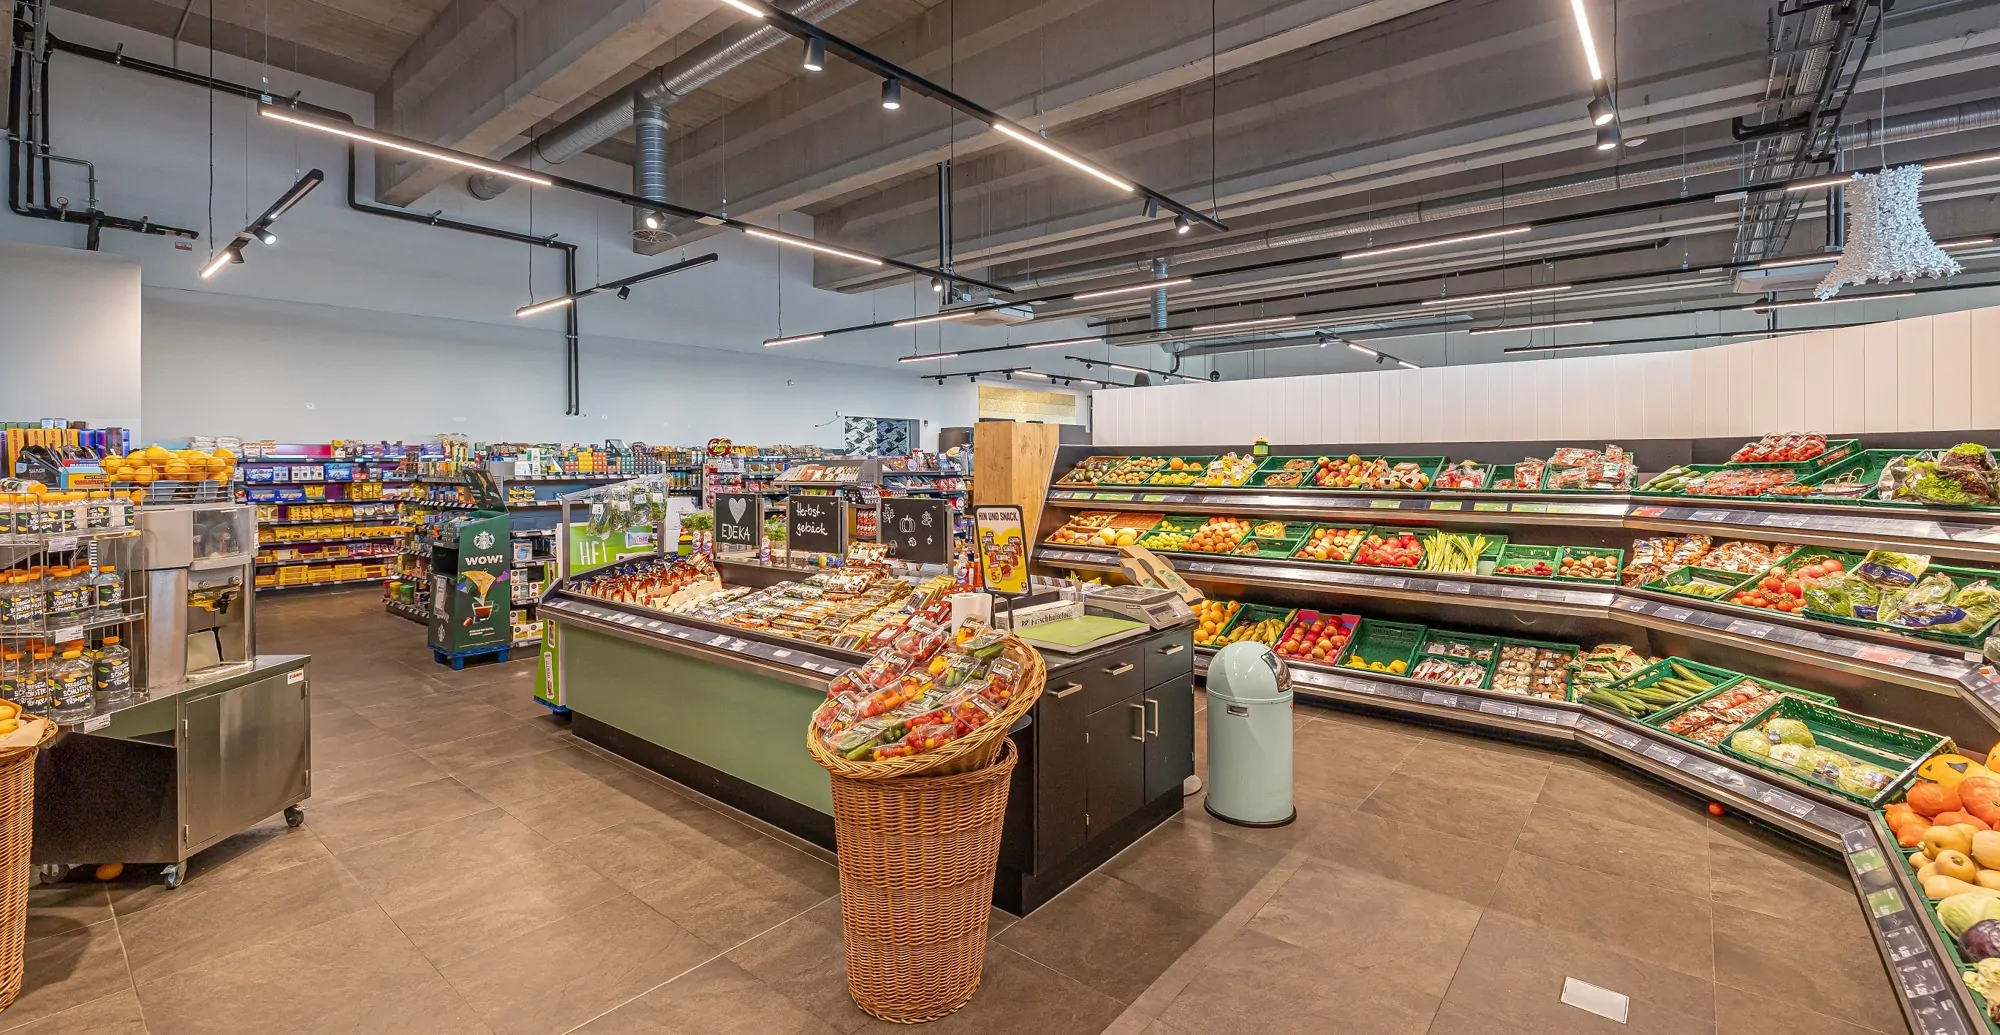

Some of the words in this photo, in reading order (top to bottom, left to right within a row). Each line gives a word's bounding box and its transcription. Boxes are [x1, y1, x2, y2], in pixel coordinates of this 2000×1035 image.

[796, 502, 826, 517] Herbst-
[988, 511, 1000, 521] UND
[1000, 511, 1019, 522] SNACK.
[721, 523, 751, 542] EDEKA
[796, 521, 828, 537] gebäck
[465, 554, 504, 566] WOW!
